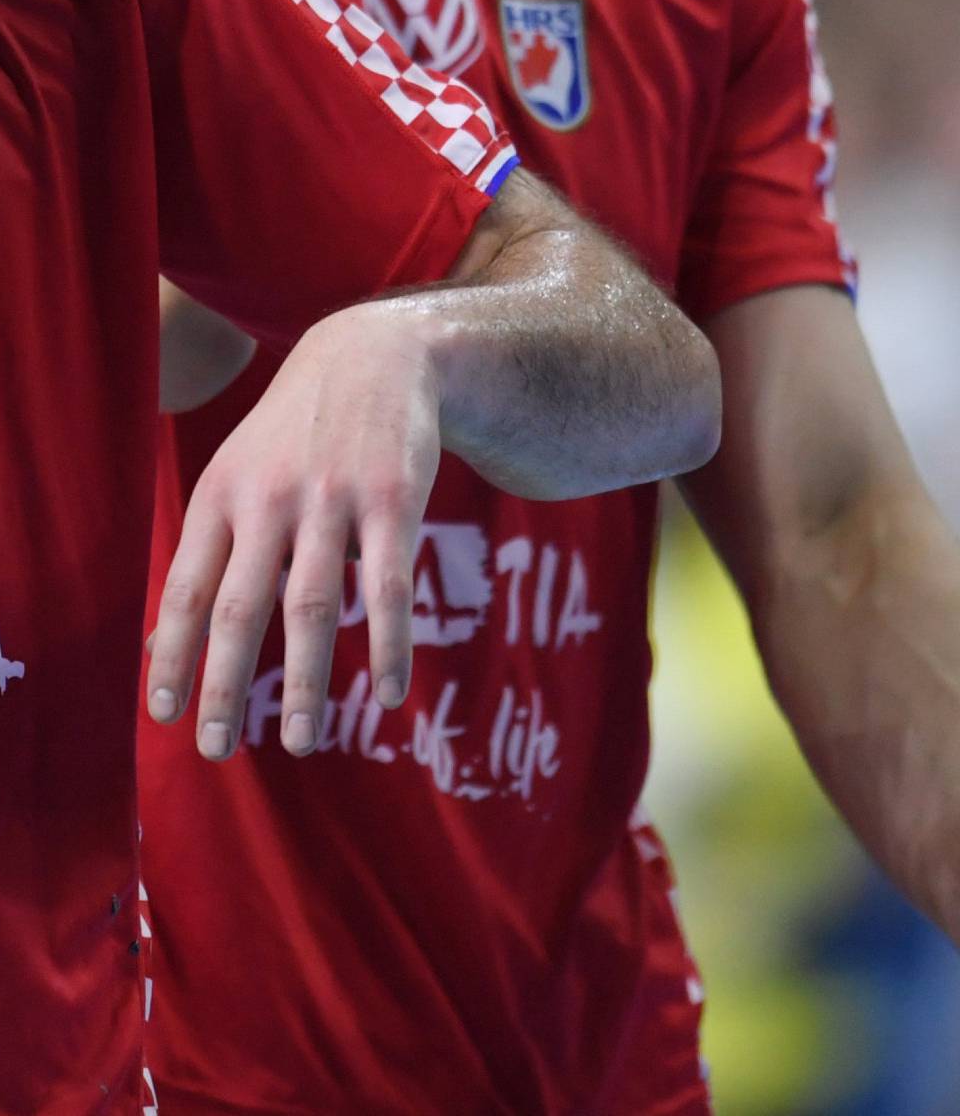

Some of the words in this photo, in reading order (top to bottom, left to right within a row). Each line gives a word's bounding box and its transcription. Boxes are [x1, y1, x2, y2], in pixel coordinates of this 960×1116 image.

[504, 5, 577, 34] HRS
[412, 681, 466, 794] of
[490, 687, 561, 800] life
